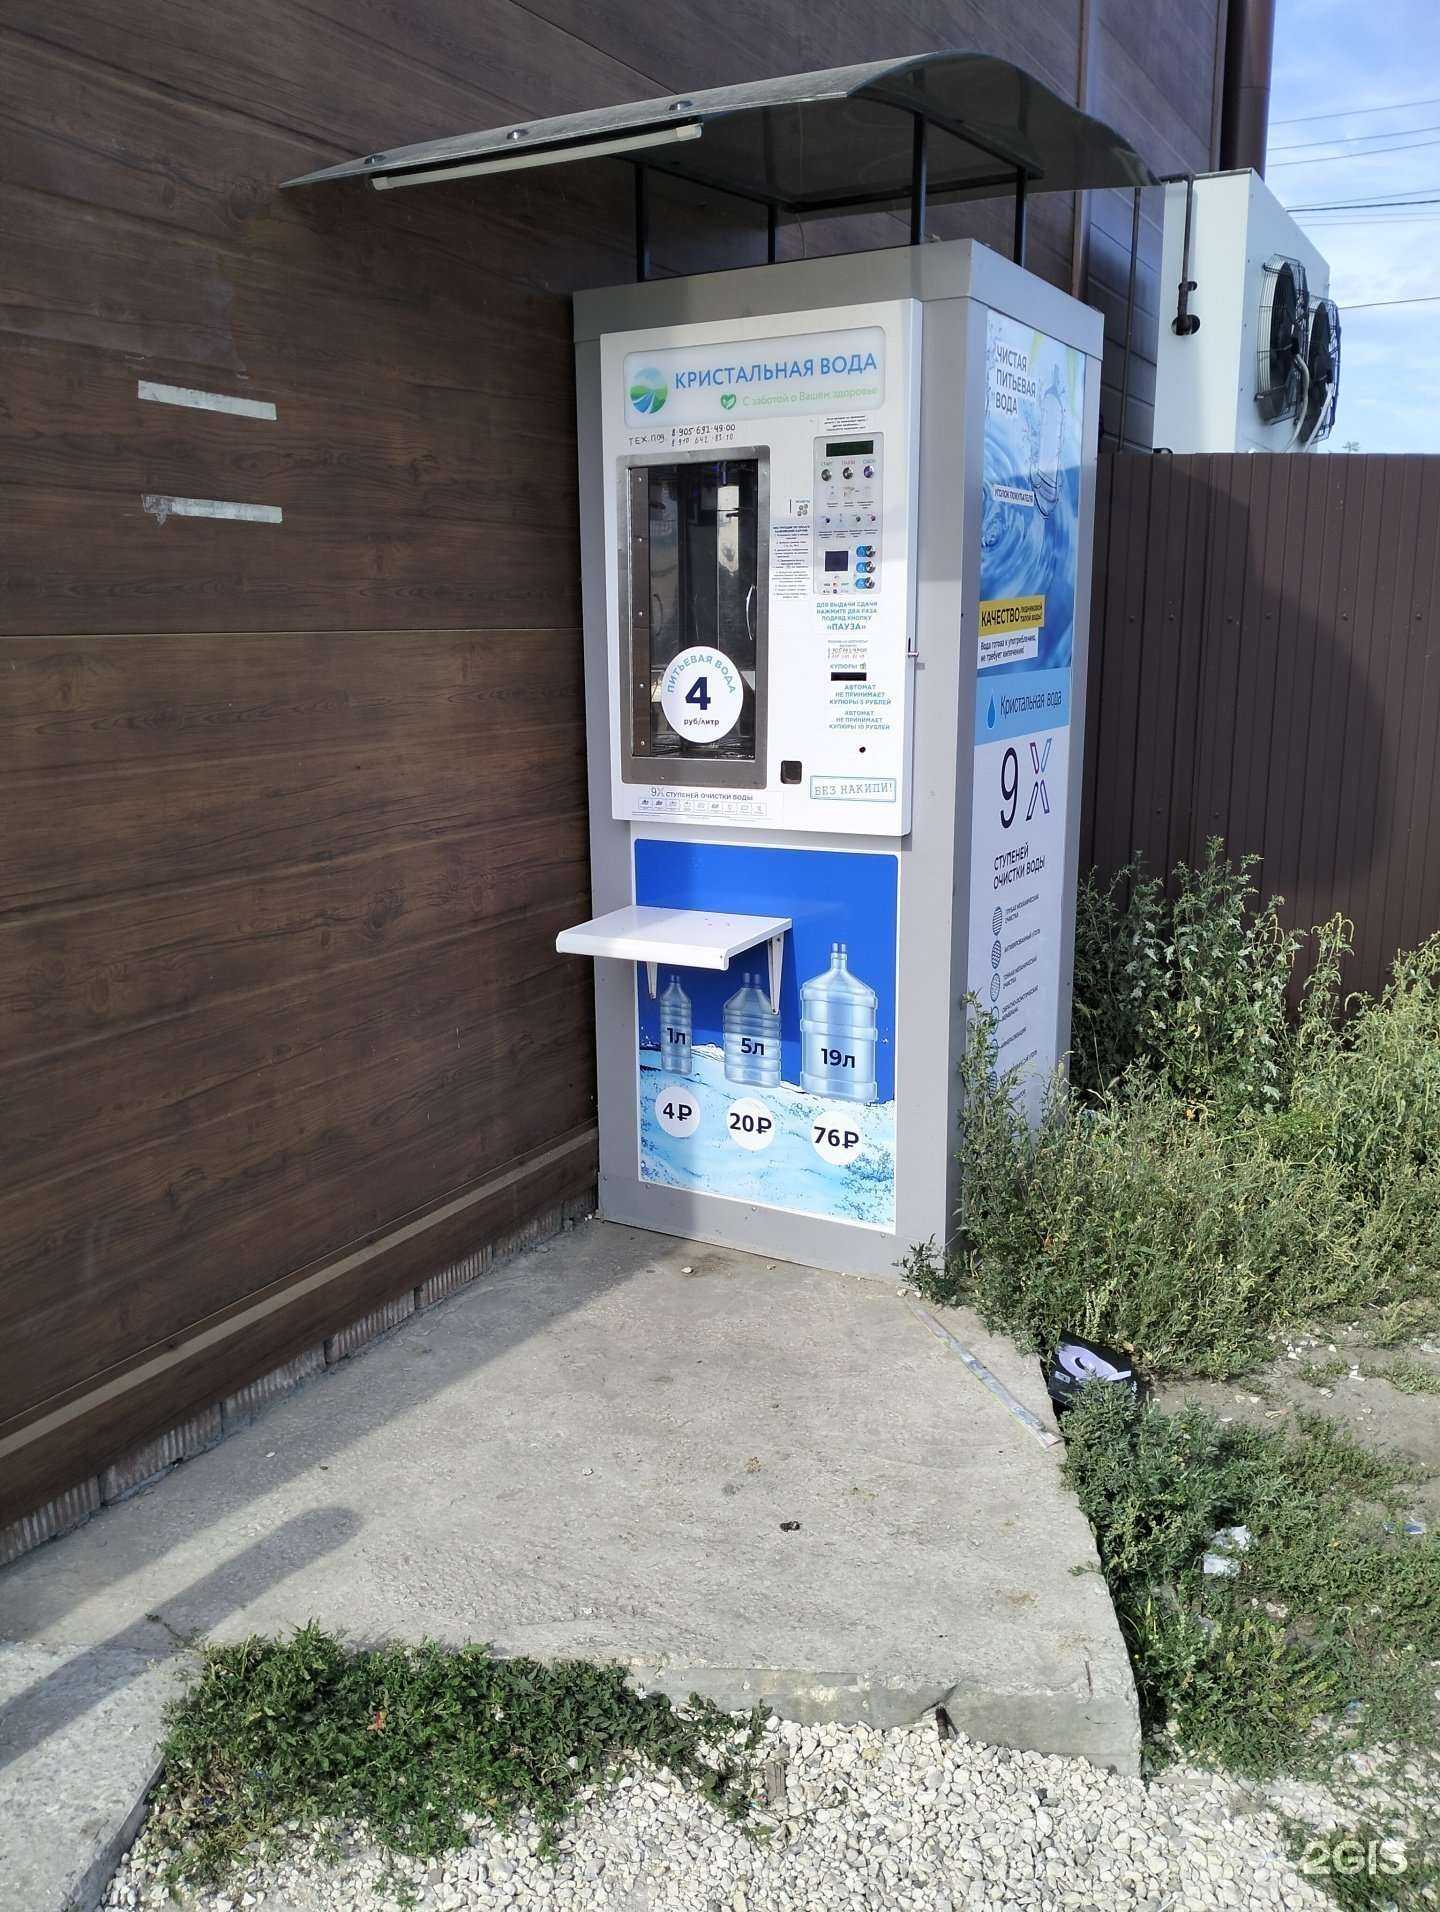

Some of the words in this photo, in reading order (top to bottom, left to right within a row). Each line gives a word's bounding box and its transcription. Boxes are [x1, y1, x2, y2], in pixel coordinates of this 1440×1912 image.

[675, 359, 813, 389] КРИСТАЛЬНАЯ
[820, 353, 877, 376] ВОДА
[995, 346, 1028, 373] ЧИСТАЯ
[996, 368, 1036, 398] ПИТЬЕВАЯ
[995, 392, 1018, 414] ВОДА
[981, 607, 1020, 627] КАЧЕСТВО
[667, 654, 713, 693] ПИТЬЕВАЯ
[714, 660, 736, 694] ВОДА
[685, 676, 711, 711] 4
[1000, 693, 1045, 720] Кристальная
[1047, 690, 1062, 709] вода
[683, 717, 720, 727] руб/литр
[665, 790, 699, 799] СТУПЕНЕЙ
[700, 792, 731, 800] ОЧИСТКИ
[814, 785, 837, 797] БЕЗ
[840, 782, 893, 795] НАКИПИ!
[994, 842, 1029, 871] СТУПЕНЕЙ
[993, 865, 1025, 890] ОЧИСТКИ
[1026, 856, 1046, 875] ВОДЫ
[667, 1027, 686, 1045] 1л
[740, 1037, 765, 1056] 5л
[821, 1048, 856, 1068] 19л
